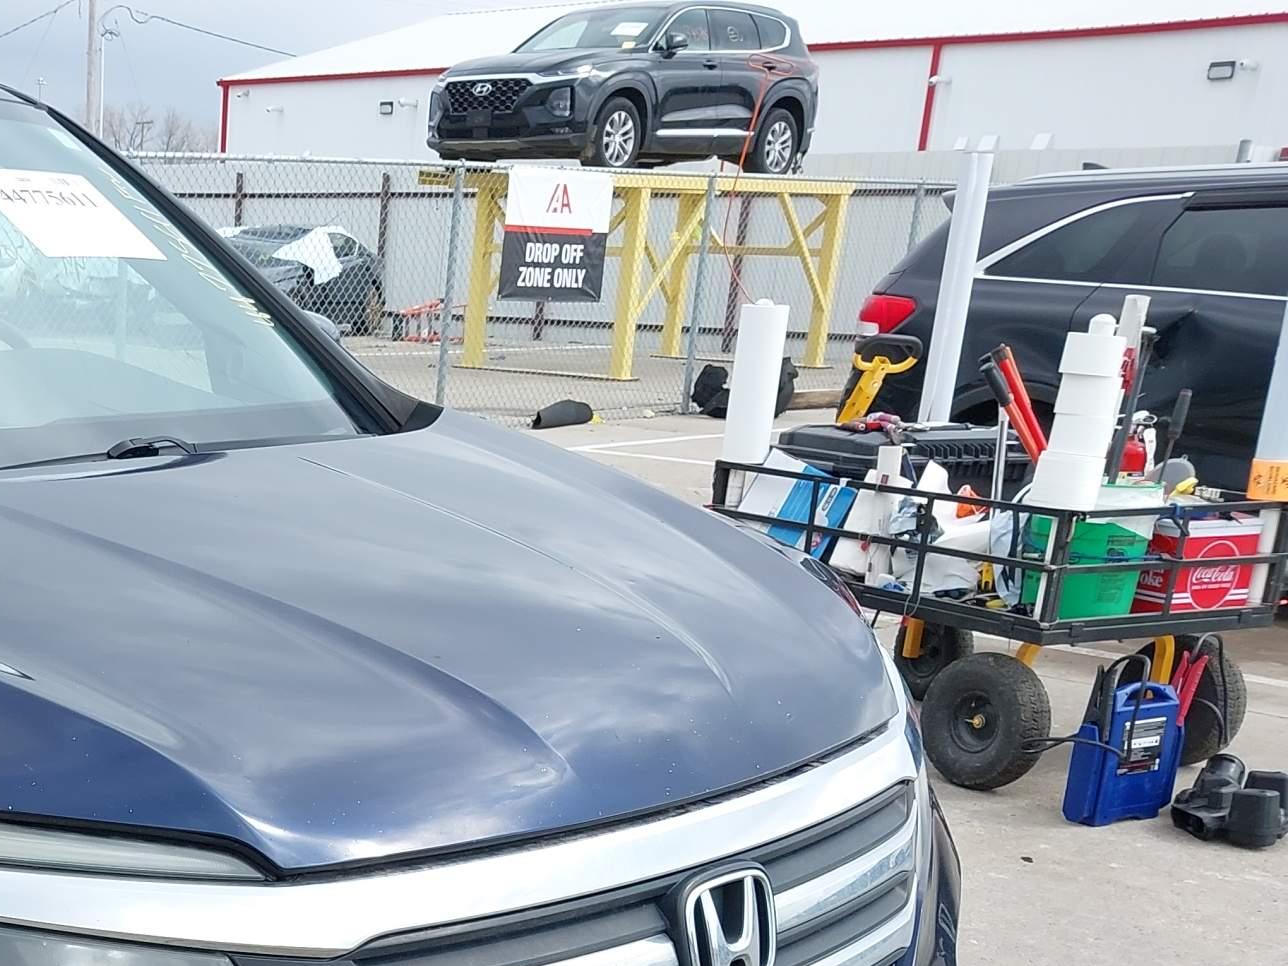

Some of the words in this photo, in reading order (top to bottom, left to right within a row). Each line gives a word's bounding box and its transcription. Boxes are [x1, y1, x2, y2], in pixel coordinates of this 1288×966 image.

[525, 242, 560, 264] DROP
[561, 243, 585, 265] OFF
[516, 266, 552, 288] ZONE
[553, 267, 587, 288] ONLY
[1140, 570, 1163, 588] oke
